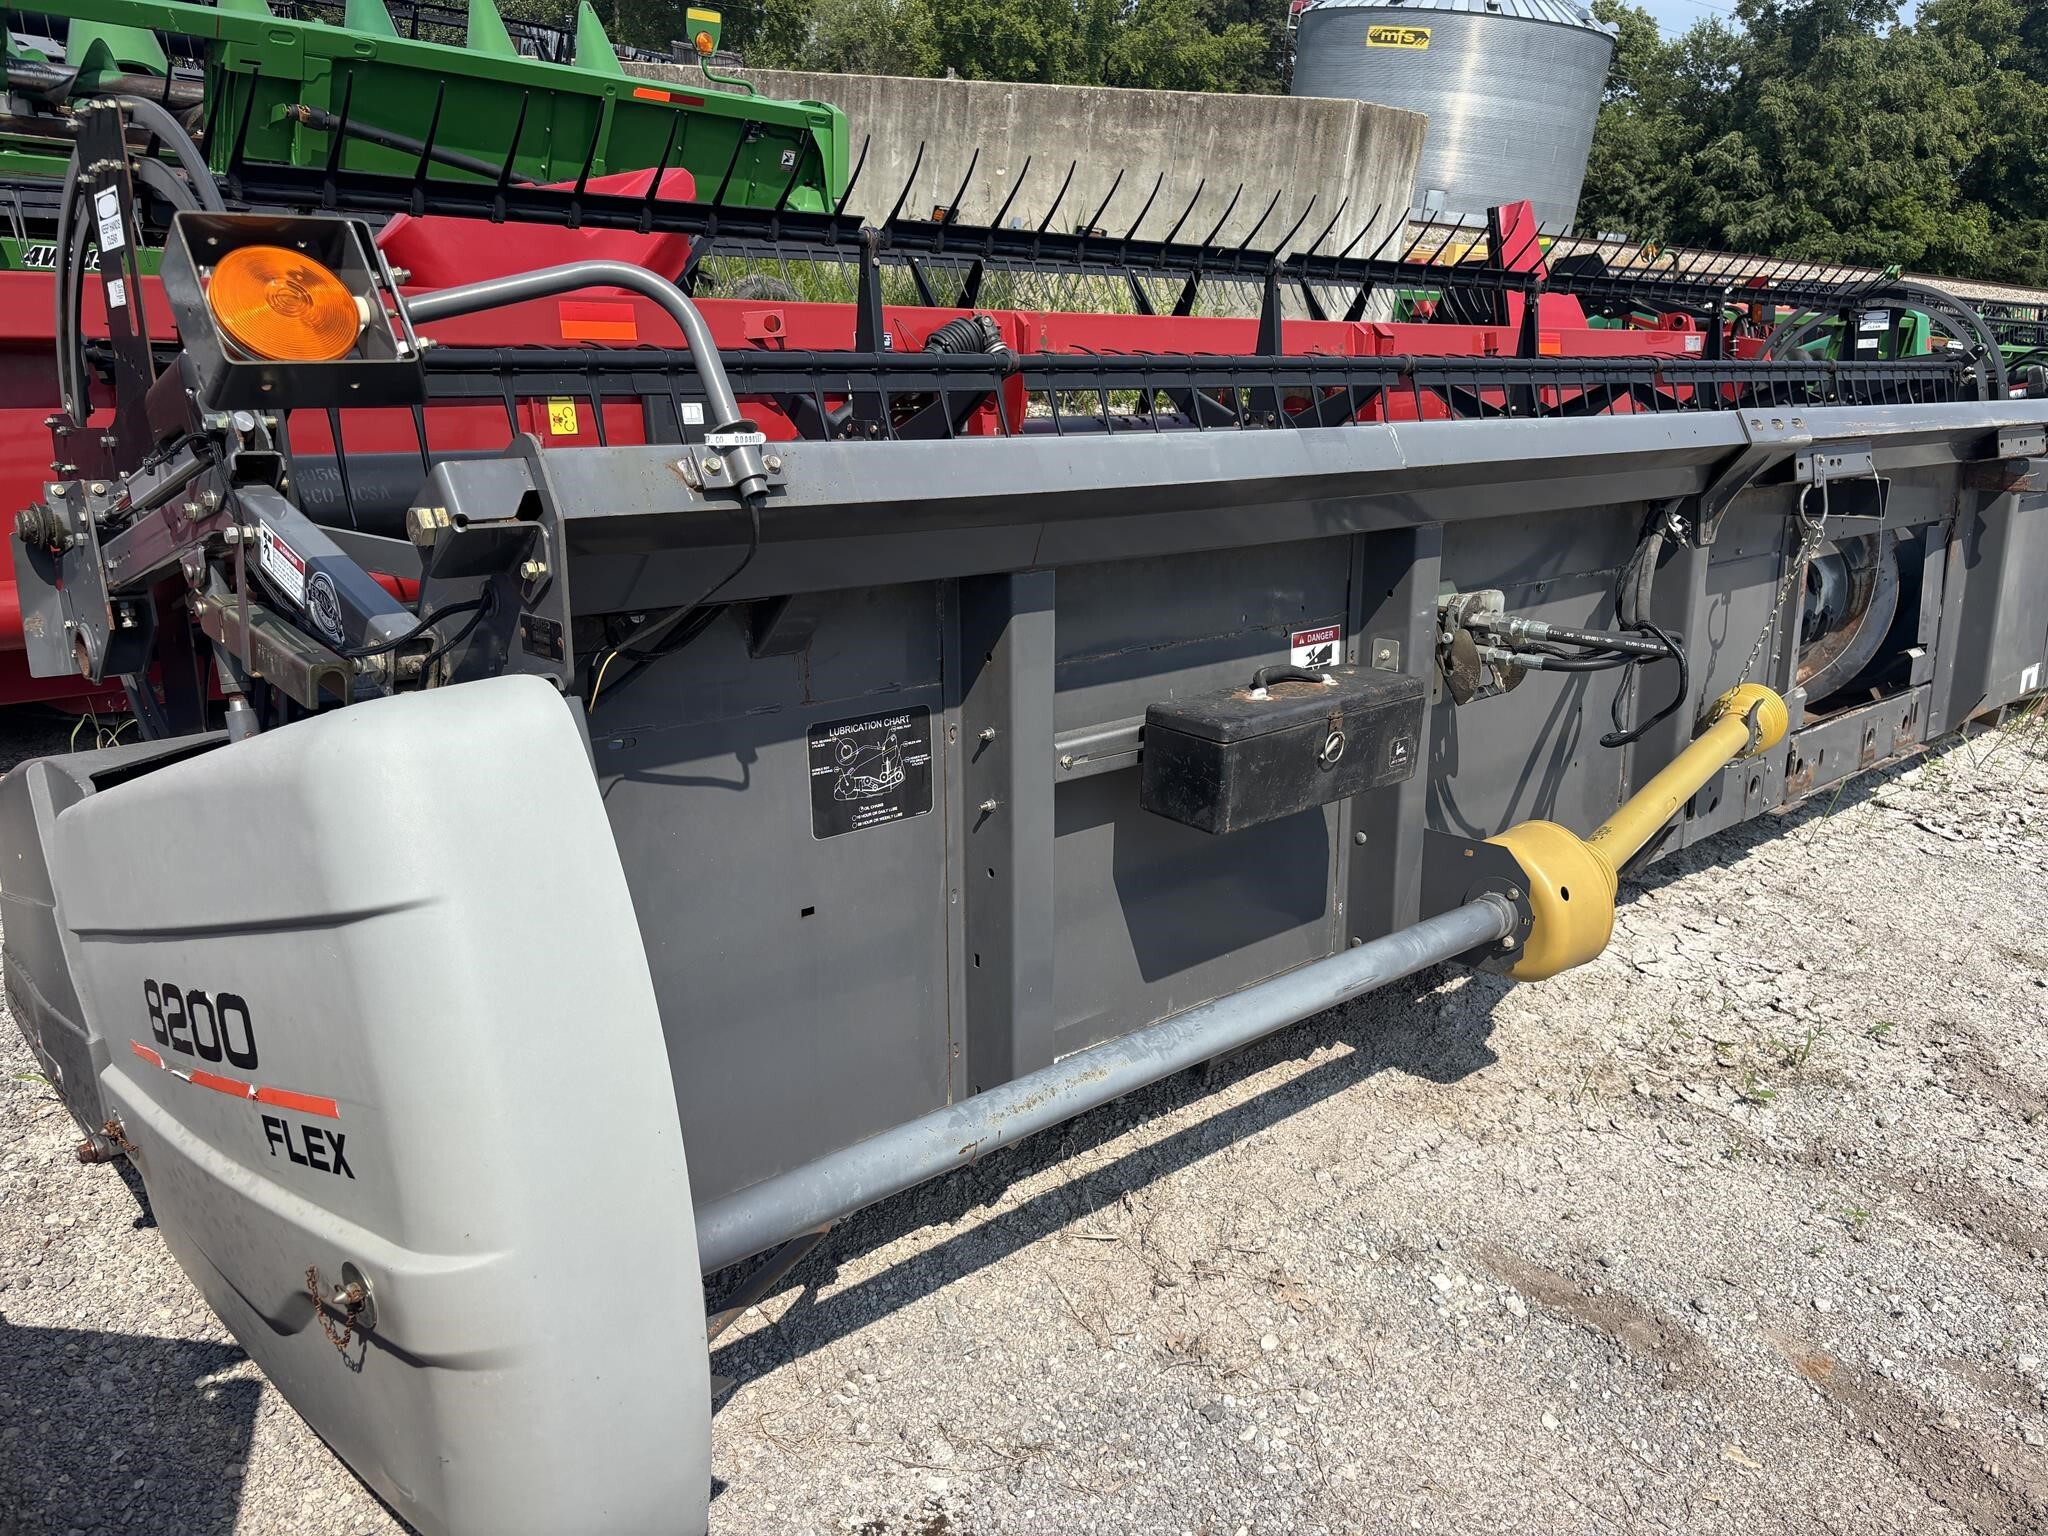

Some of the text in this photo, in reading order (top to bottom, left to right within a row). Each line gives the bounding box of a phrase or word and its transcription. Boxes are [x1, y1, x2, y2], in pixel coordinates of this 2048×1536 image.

[1380, 30, 1416, 45] mfs
[1307, 630, 1334, 643] DANGER
[829, 715, 910, 737] LUBRICATION CHART
[144, 978, 259, 1070] 8200
[261, 1114, 356, 1180] FLEX
